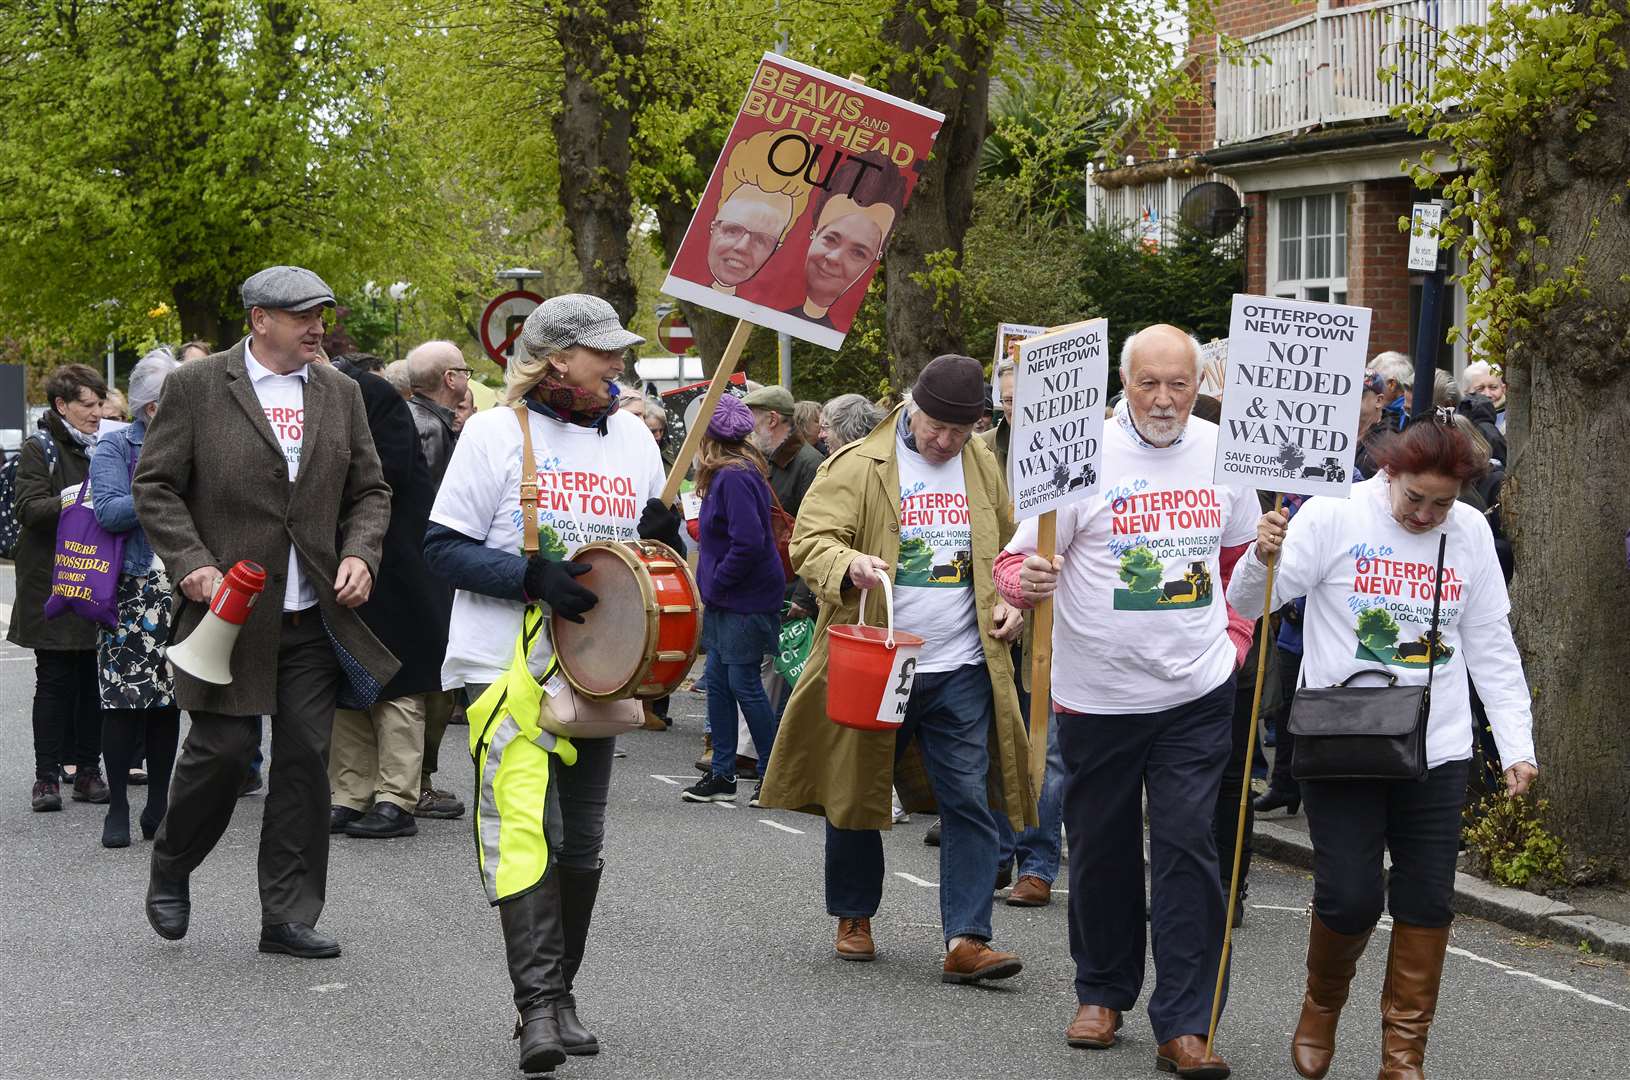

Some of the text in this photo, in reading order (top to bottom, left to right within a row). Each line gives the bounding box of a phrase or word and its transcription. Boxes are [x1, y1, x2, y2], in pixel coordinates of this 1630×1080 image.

[754, 65, 890, 132] BEAVIS AND
[743, 91, 914, 168] BUTT-HEAD
[768, 134, 883, 199] OUT
[1243, 305, 1358, 328] OTTERPOOL
[1244, 319, 1354, 342] NEW TOWN
[1027, 332, 1101, 362] OTTERPOOL
[1267, 341, 1328, 367] NOT
[1028, 345, 1100, 375] NEW TOWN
[1041, 367, 1082, 396] NOT
[1235, 364, 1351, 396] NEEDED
[1023, 387, 1099, 426] NEEDED
[1246, 396, 1336, 426] & NOT
[1030, 416, 1089, 452] & NOT
[1228, 420, 1348, 452] WANTED
[1018, 438, 1097, 478] WANTED
[1224, 462, 1296, 479] COUNTRYSIDE
[1225, 452, 1276, 466] SAVE OUR
[537, 472, 636, 497] TTERPOOL
[1020, 481, 1053, 500] SAVE OUR
[1134, 479, 1148, 492] to
[520, 489, 636, 520] EW TOWN
[1020, 488, 1066, 510] COUNTRYSIDE
[1112, 489, 1220, 514] OTTERPOOL
[541, 510, 554, 520] to
[1112, 510, 1220, 535] NEW TOWN
[588, 524, 620, 536] HOMES
[1136, 535, 1148, 546] to
[1146, 539, 1175, 548] LOCAL
[1178, 536, 1208, 546] HOMES
[64, 540, 97, 555] WHERE
[1157, 549, 1186, 559] LOCAL
[1380, 544, 1393, 556] to
[1356, 557, 1462, 584] OTTERPOOL
[1354, 576, 1462, 602] NEW TOWN
[1374, 596, 1386, 606] to
[1385, 602, 1414, 612] LOCAL
[1394, 613, 1422, 624] LOCAL
[781, 648, 800, 664] OF
[895, 657, 916, 696] £
